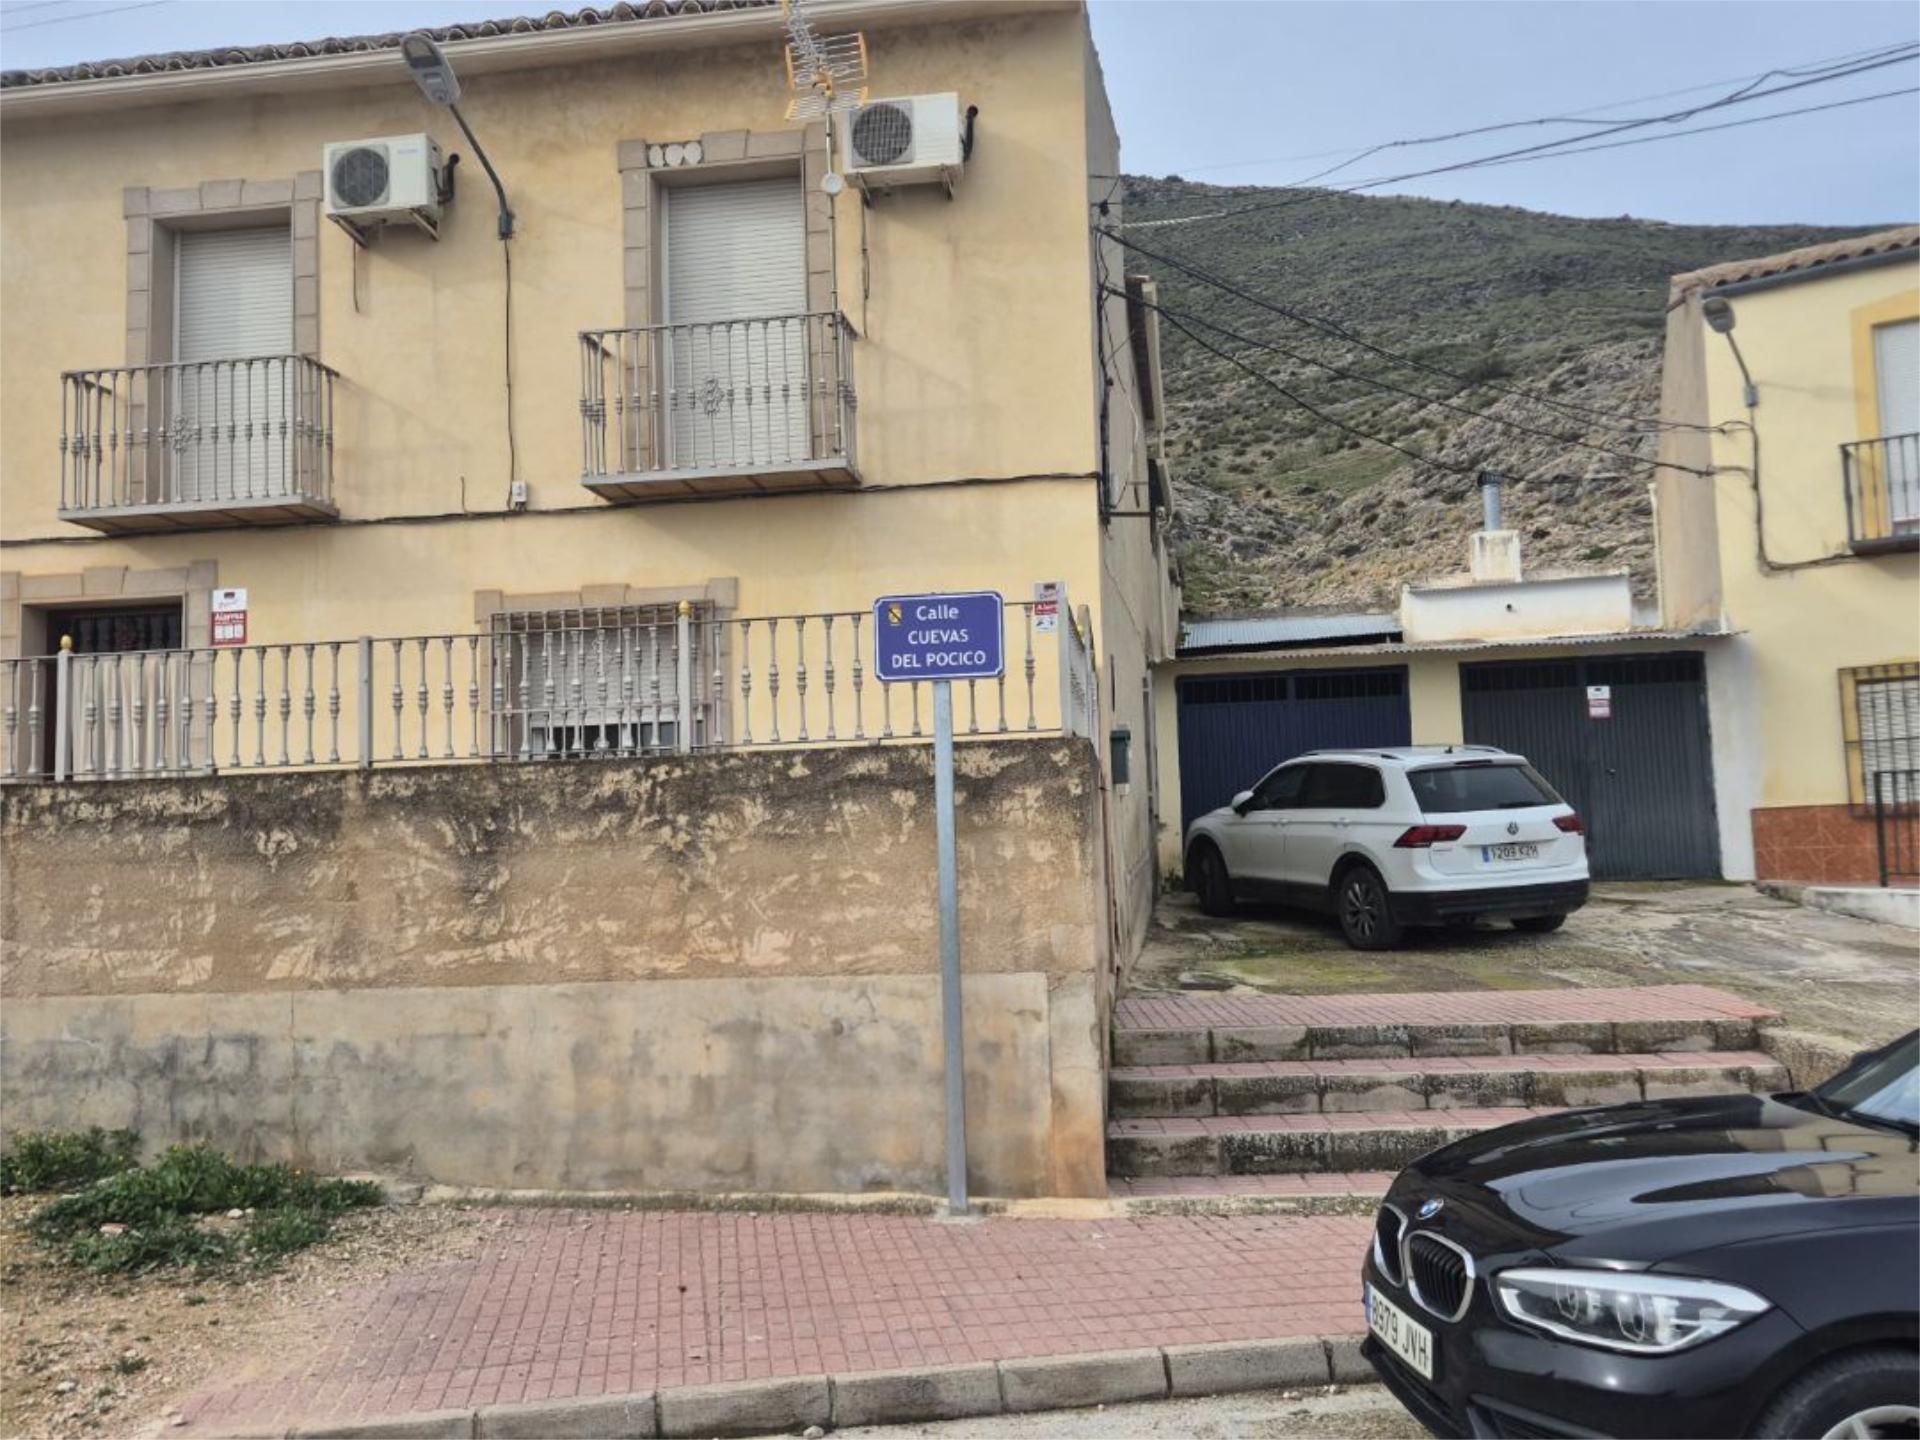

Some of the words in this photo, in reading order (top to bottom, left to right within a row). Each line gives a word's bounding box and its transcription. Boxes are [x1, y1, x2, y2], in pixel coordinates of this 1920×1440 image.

[916, 604, 960, 621] Calle
[907, 628, 970, 645] CUEVAS
[891, 653, 922, 669] DEL
[925, 650, 987, 667] POCICO
